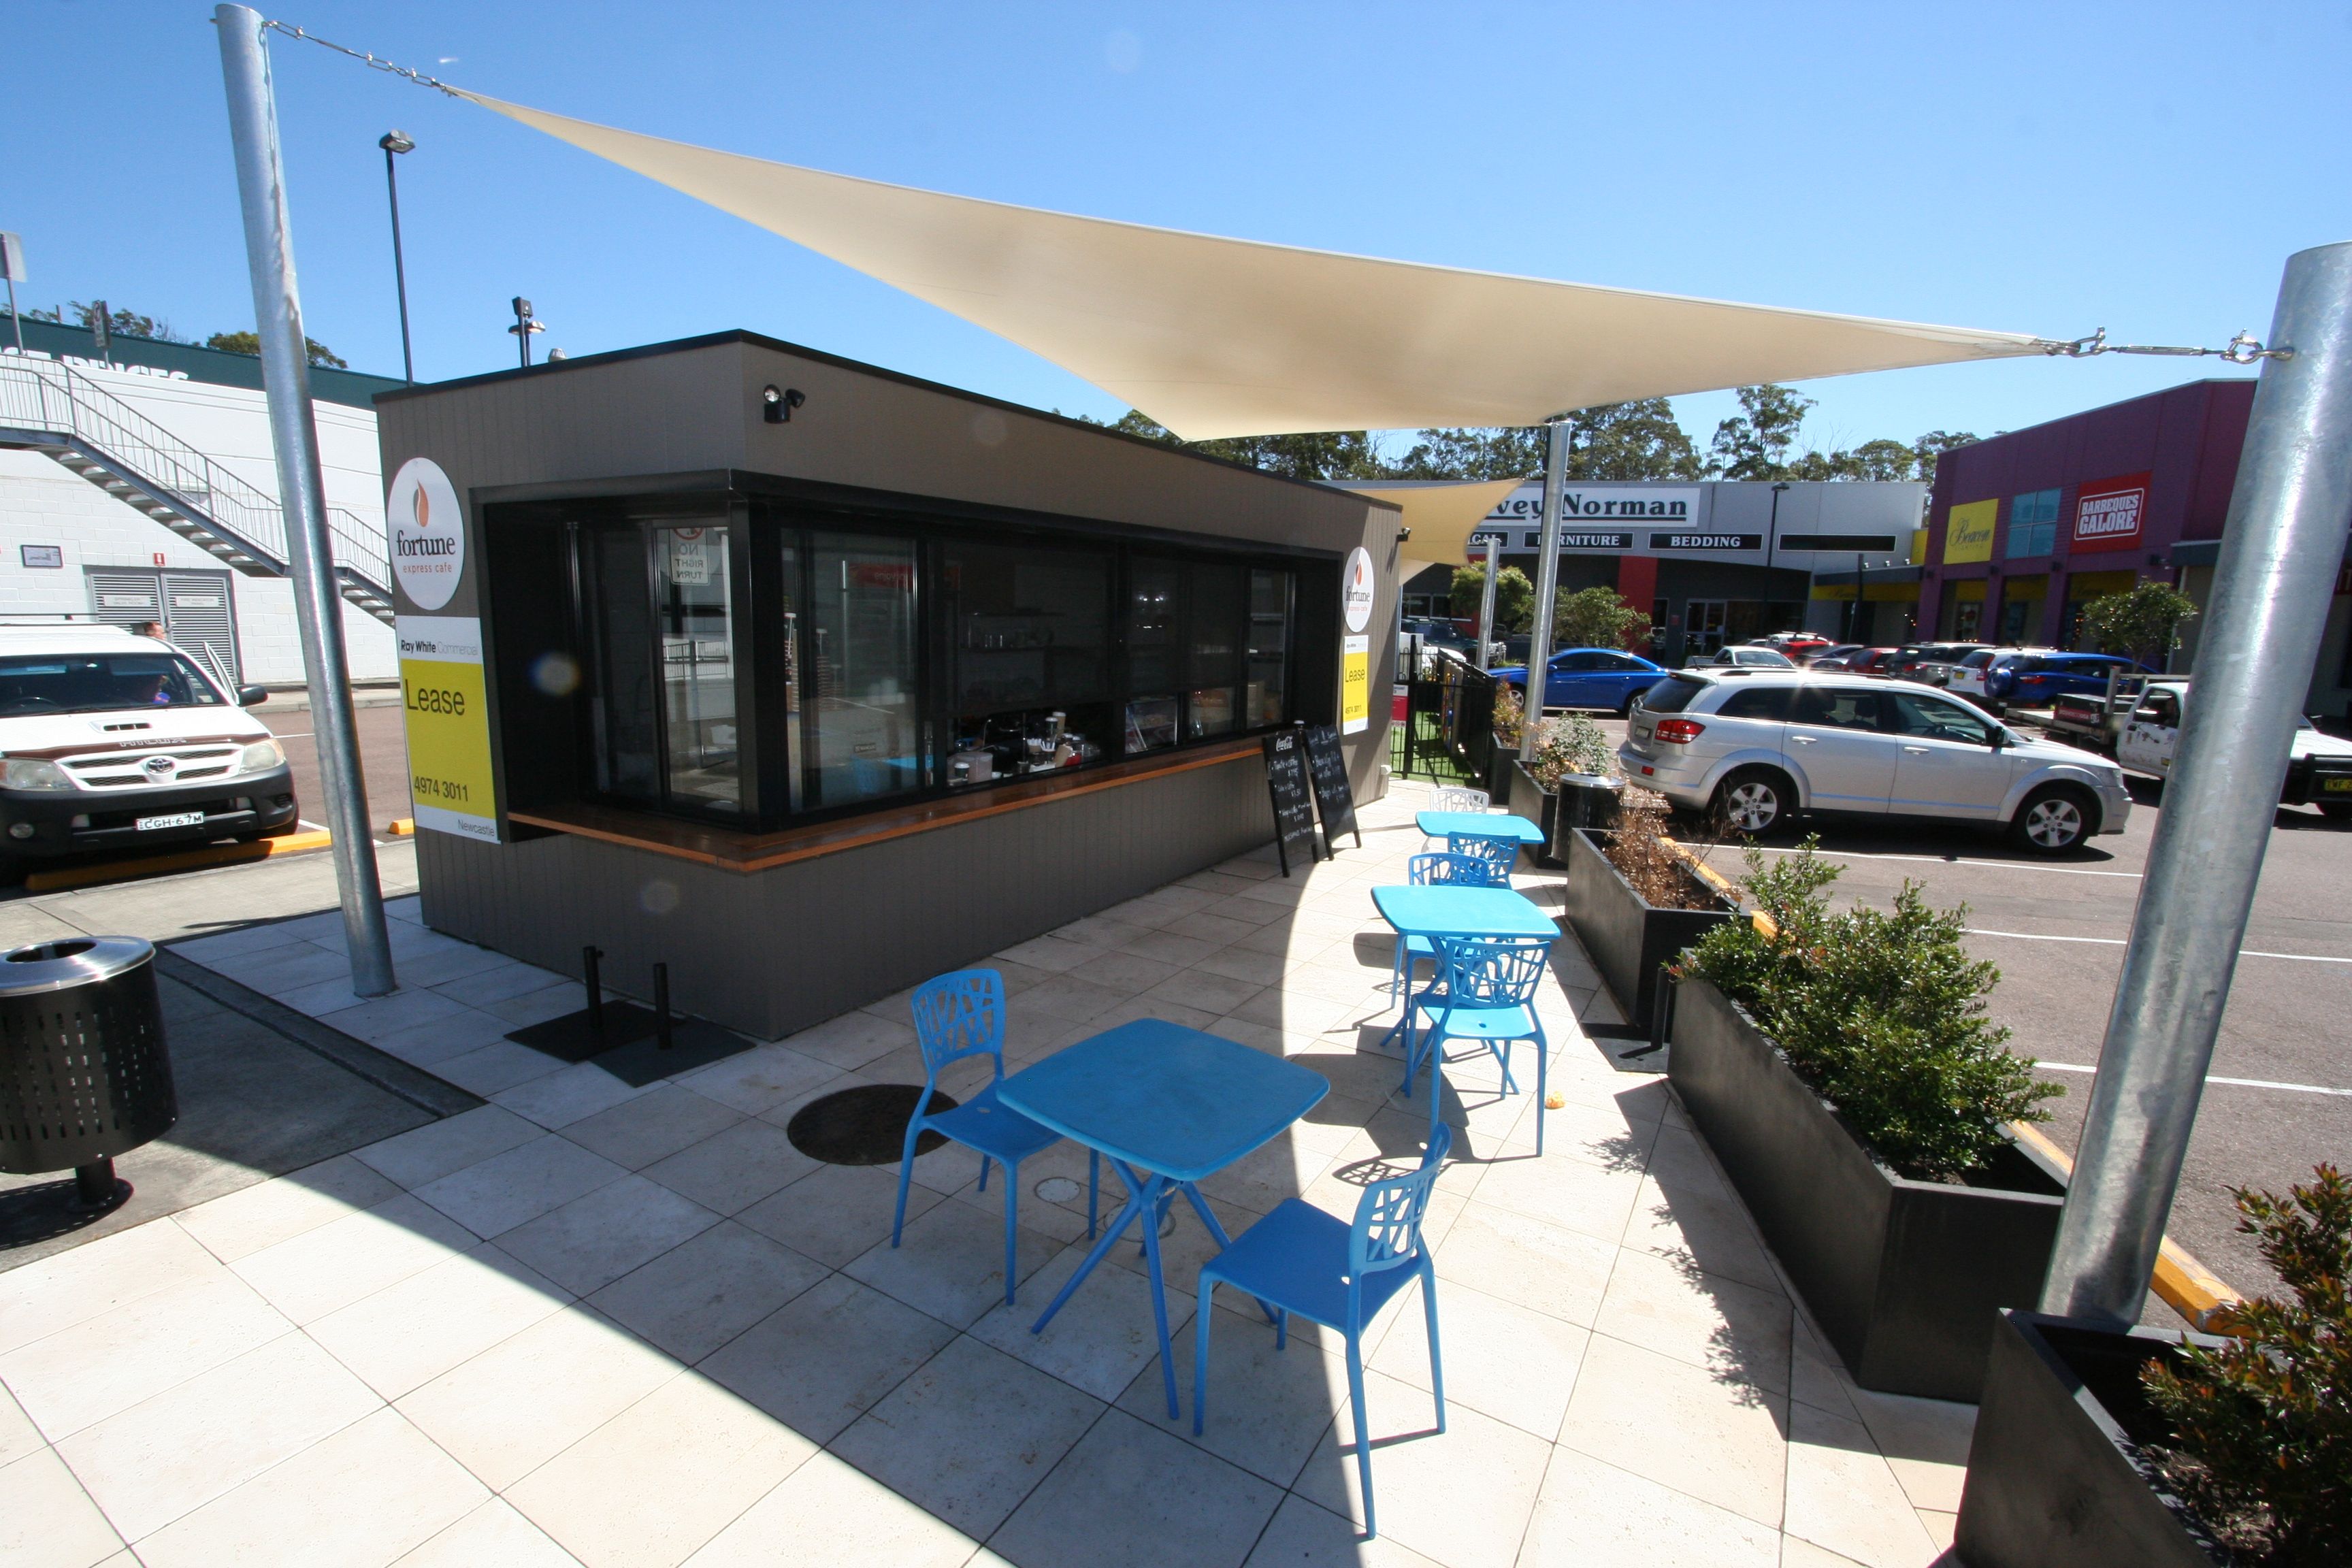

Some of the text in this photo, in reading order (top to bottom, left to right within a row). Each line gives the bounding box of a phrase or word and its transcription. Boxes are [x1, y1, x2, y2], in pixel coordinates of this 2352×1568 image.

[1563, 494, 1686, 515] Norman
[2081, 495, 2140, 515] BARBEQUES
[2078, 510, 2136, 535] GALORE
[397, 530, 455, 556] fortune
[1671, 536, 1741, 547] BEDDING
[403, 564, 452, 574] express cafe
[1346, 586, 1371, 602] fortune
[401, 640, 478, 655] Ray White Commercial
[1345, 668, 1365, 683] Lease
[405, 679, 466, 715] Lease
[414, 776, 468, 802] 4974 3011
[458, 819, 495, 836] Newcastle
